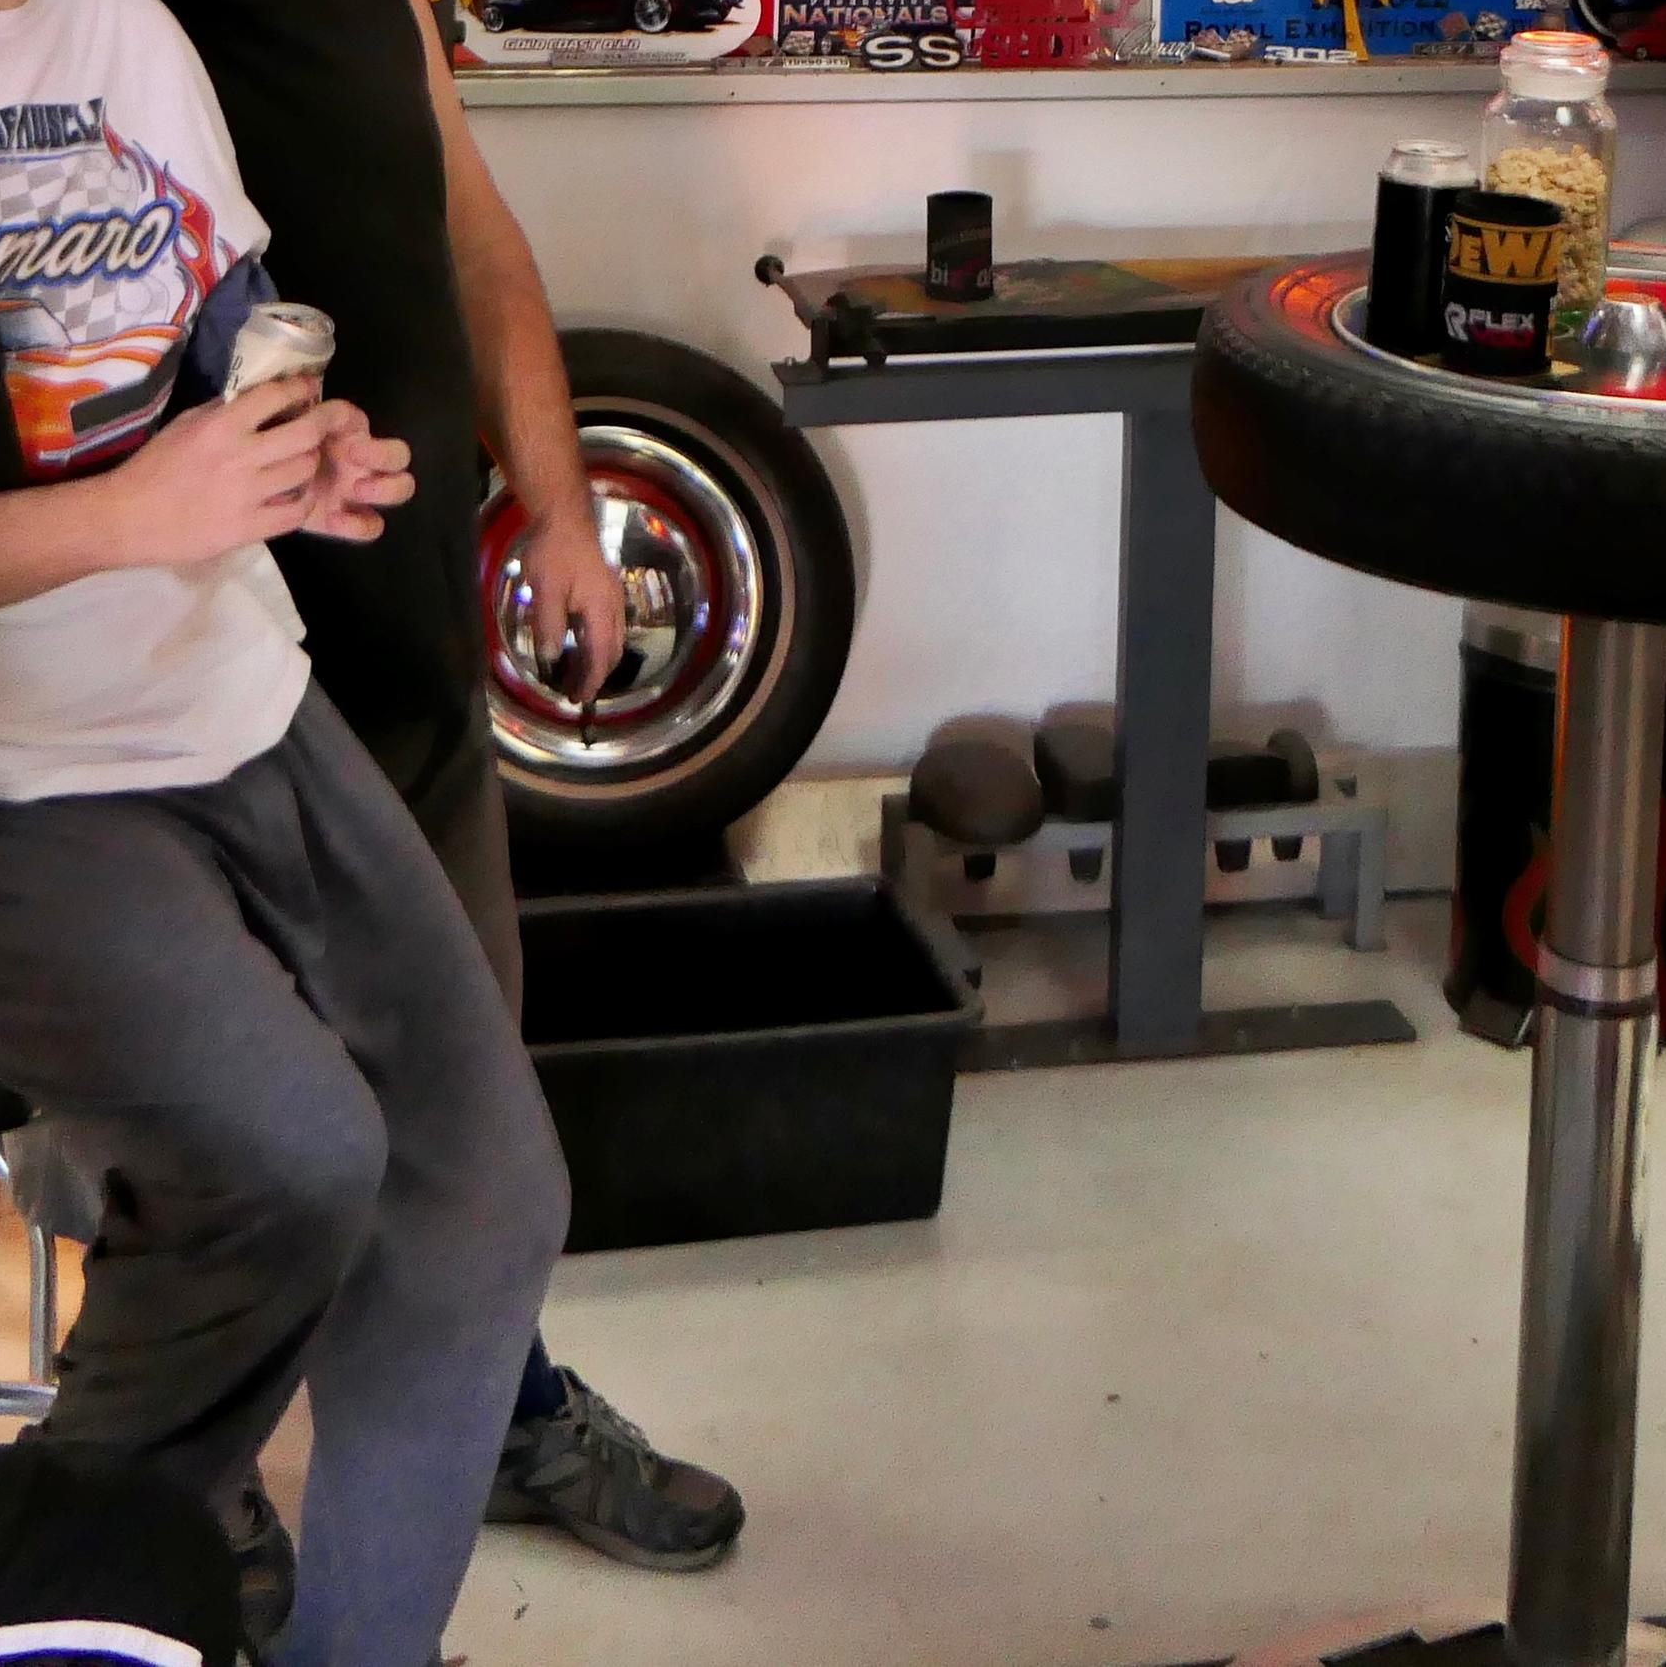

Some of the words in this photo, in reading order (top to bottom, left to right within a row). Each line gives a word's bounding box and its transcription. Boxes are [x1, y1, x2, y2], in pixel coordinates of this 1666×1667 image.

[782, 3, 950, 26] NATIONALS
[865, 36, 963, 68] SS
[1264, 45, 1359, 64] 302
